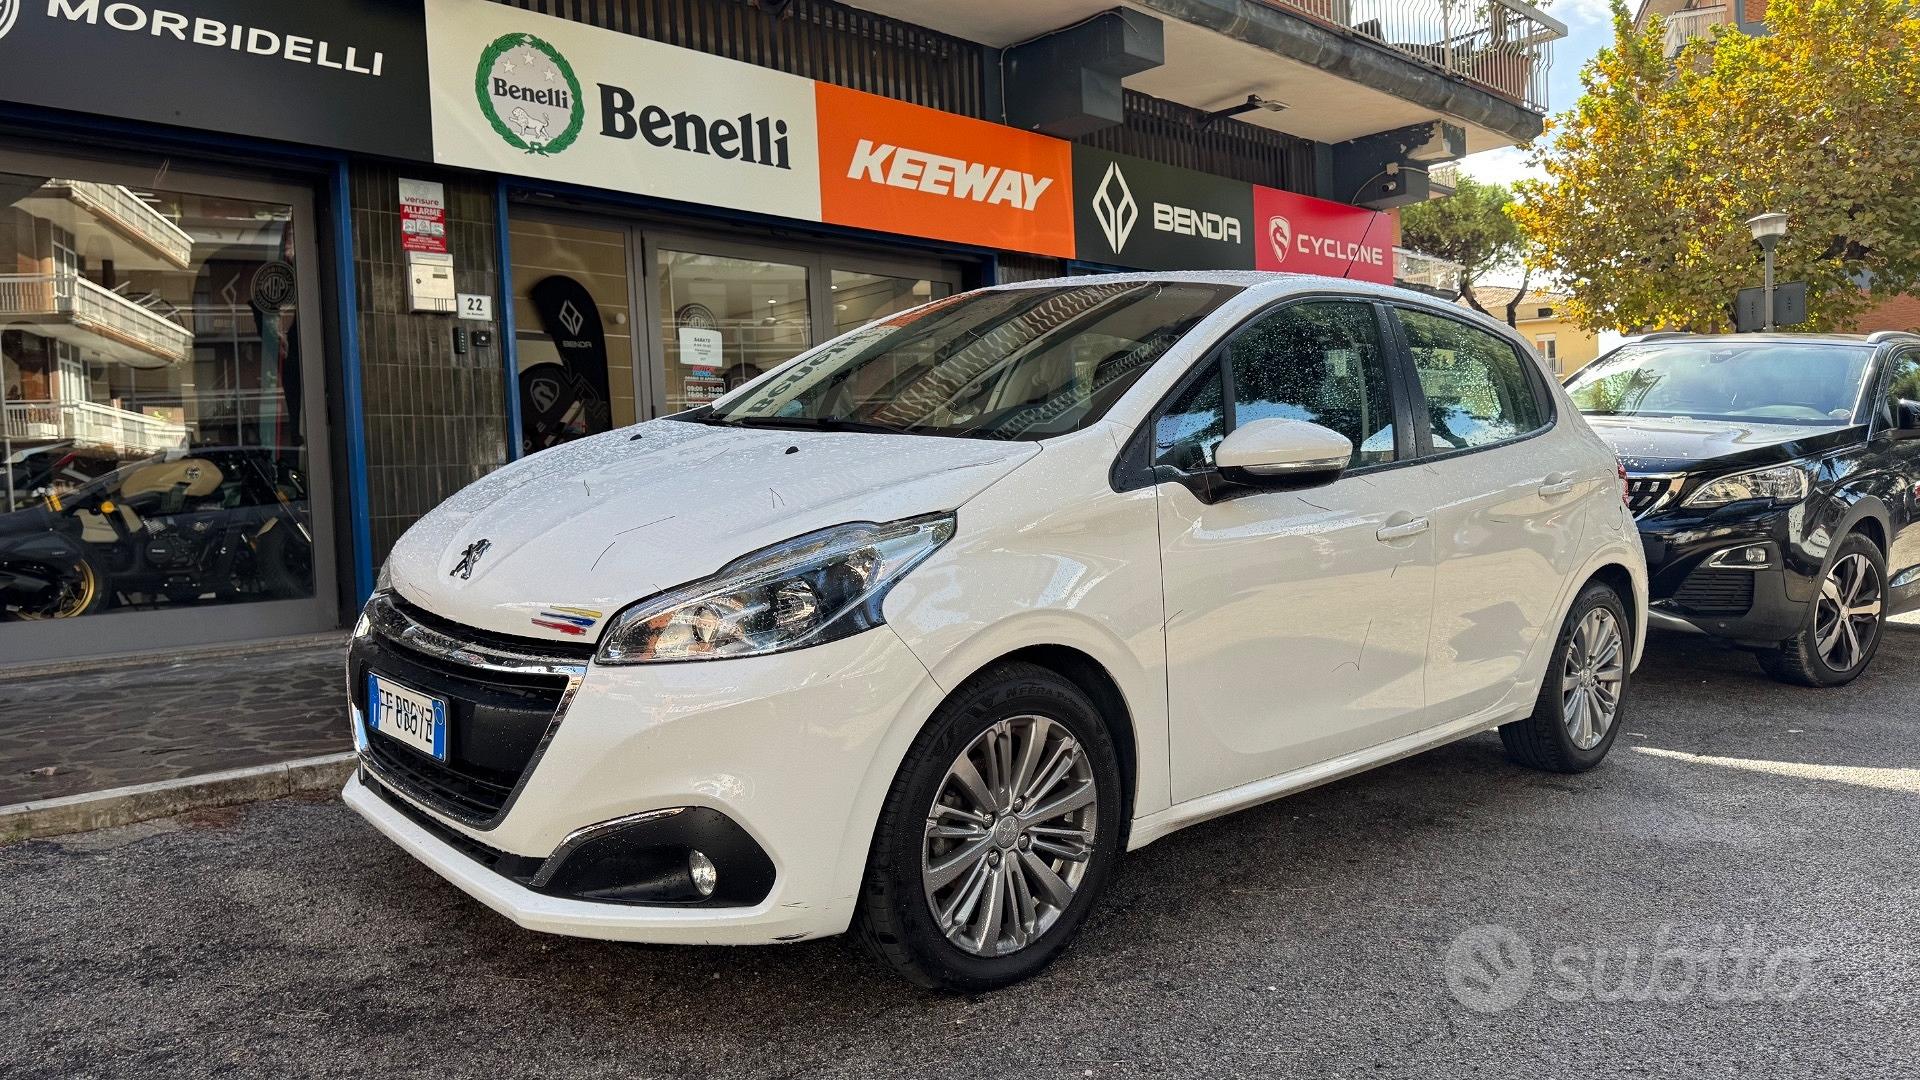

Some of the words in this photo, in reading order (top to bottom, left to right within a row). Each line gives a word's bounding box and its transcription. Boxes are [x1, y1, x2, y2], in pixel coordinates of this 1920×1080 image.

[47, 0, 384, 77] MORBIDELLI
[493, 77, 569, 110] Benelli
[596, 82, 792, 170] Benelli
[847, 138, 1054, 212] KEEWAY
[403, 205, 442, 218] ALLARME
[404, 195, 440, 206] verisure
[1153, 202, 1241, 245] BENDA
[1297, 234, 1383, 266] CYCLONE
[467, 297, 483, 311] 22
